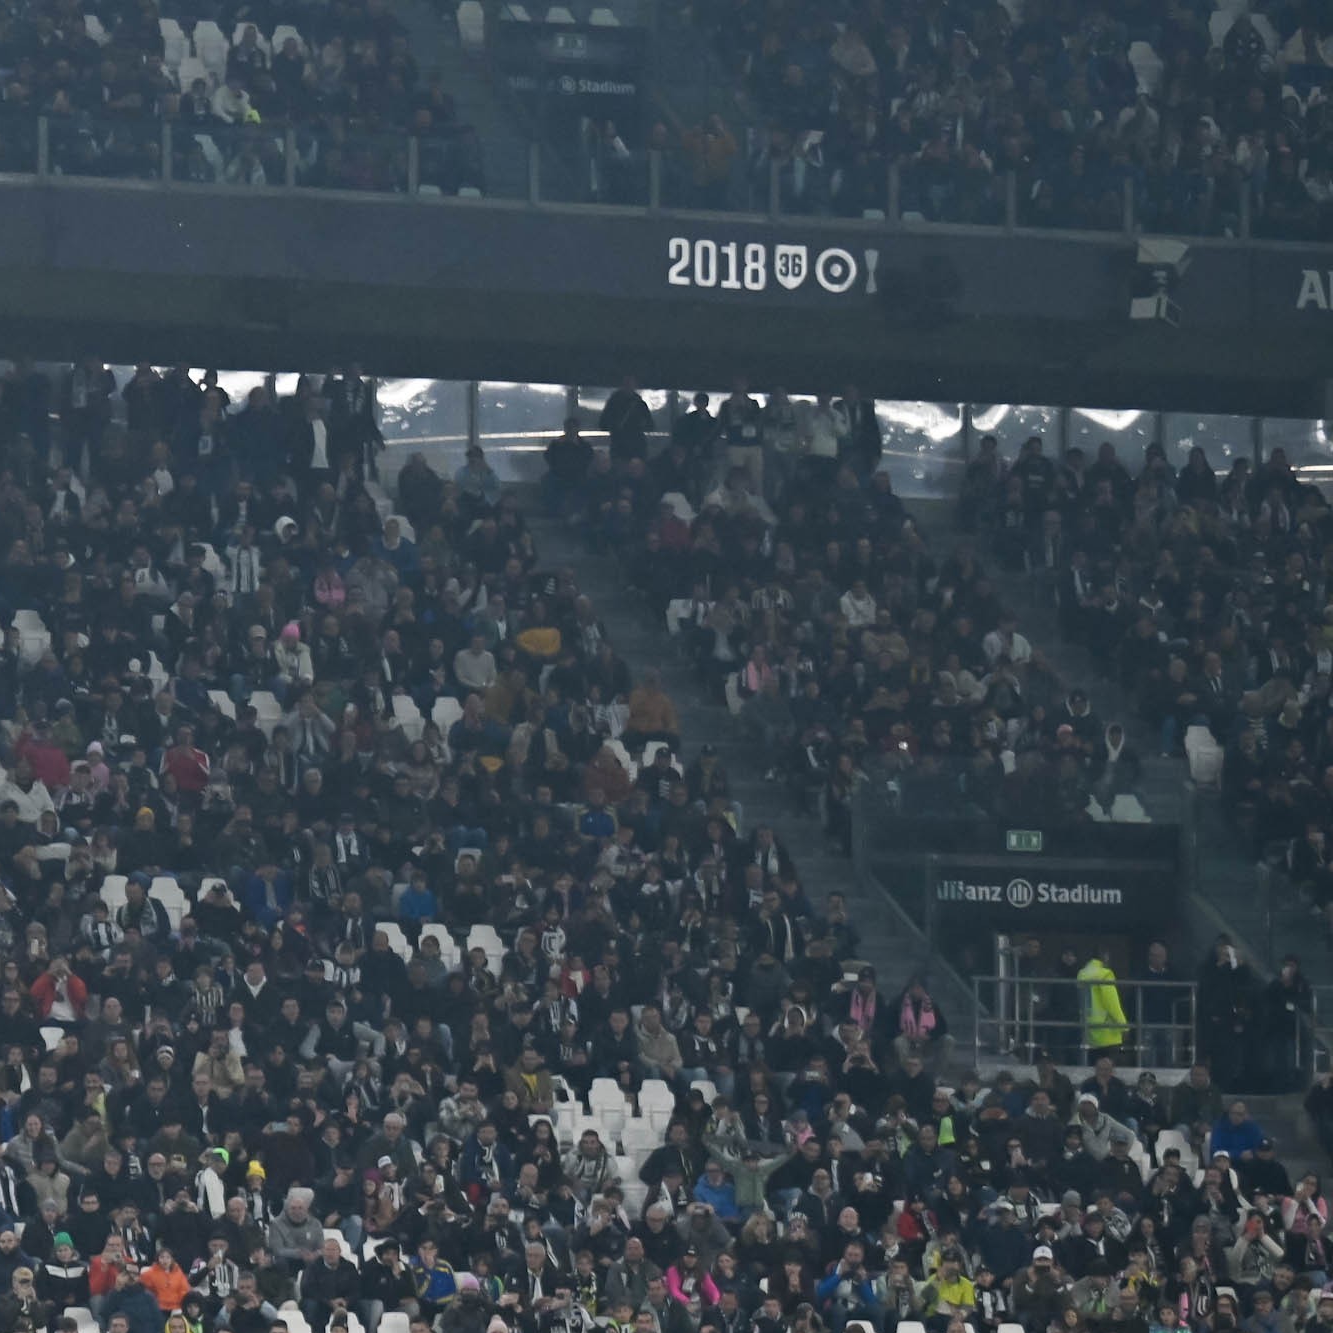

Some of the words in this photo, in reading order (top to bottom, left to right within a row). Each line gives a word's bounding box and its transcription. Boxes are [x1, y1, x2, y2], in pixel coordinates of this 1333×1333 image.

[578, 79, 636, 95] Stadium
[668, 237, 766, 291] 2018
[779, 253, 803, 280] 36
[1037, 883, 1122, 904] Stadium
